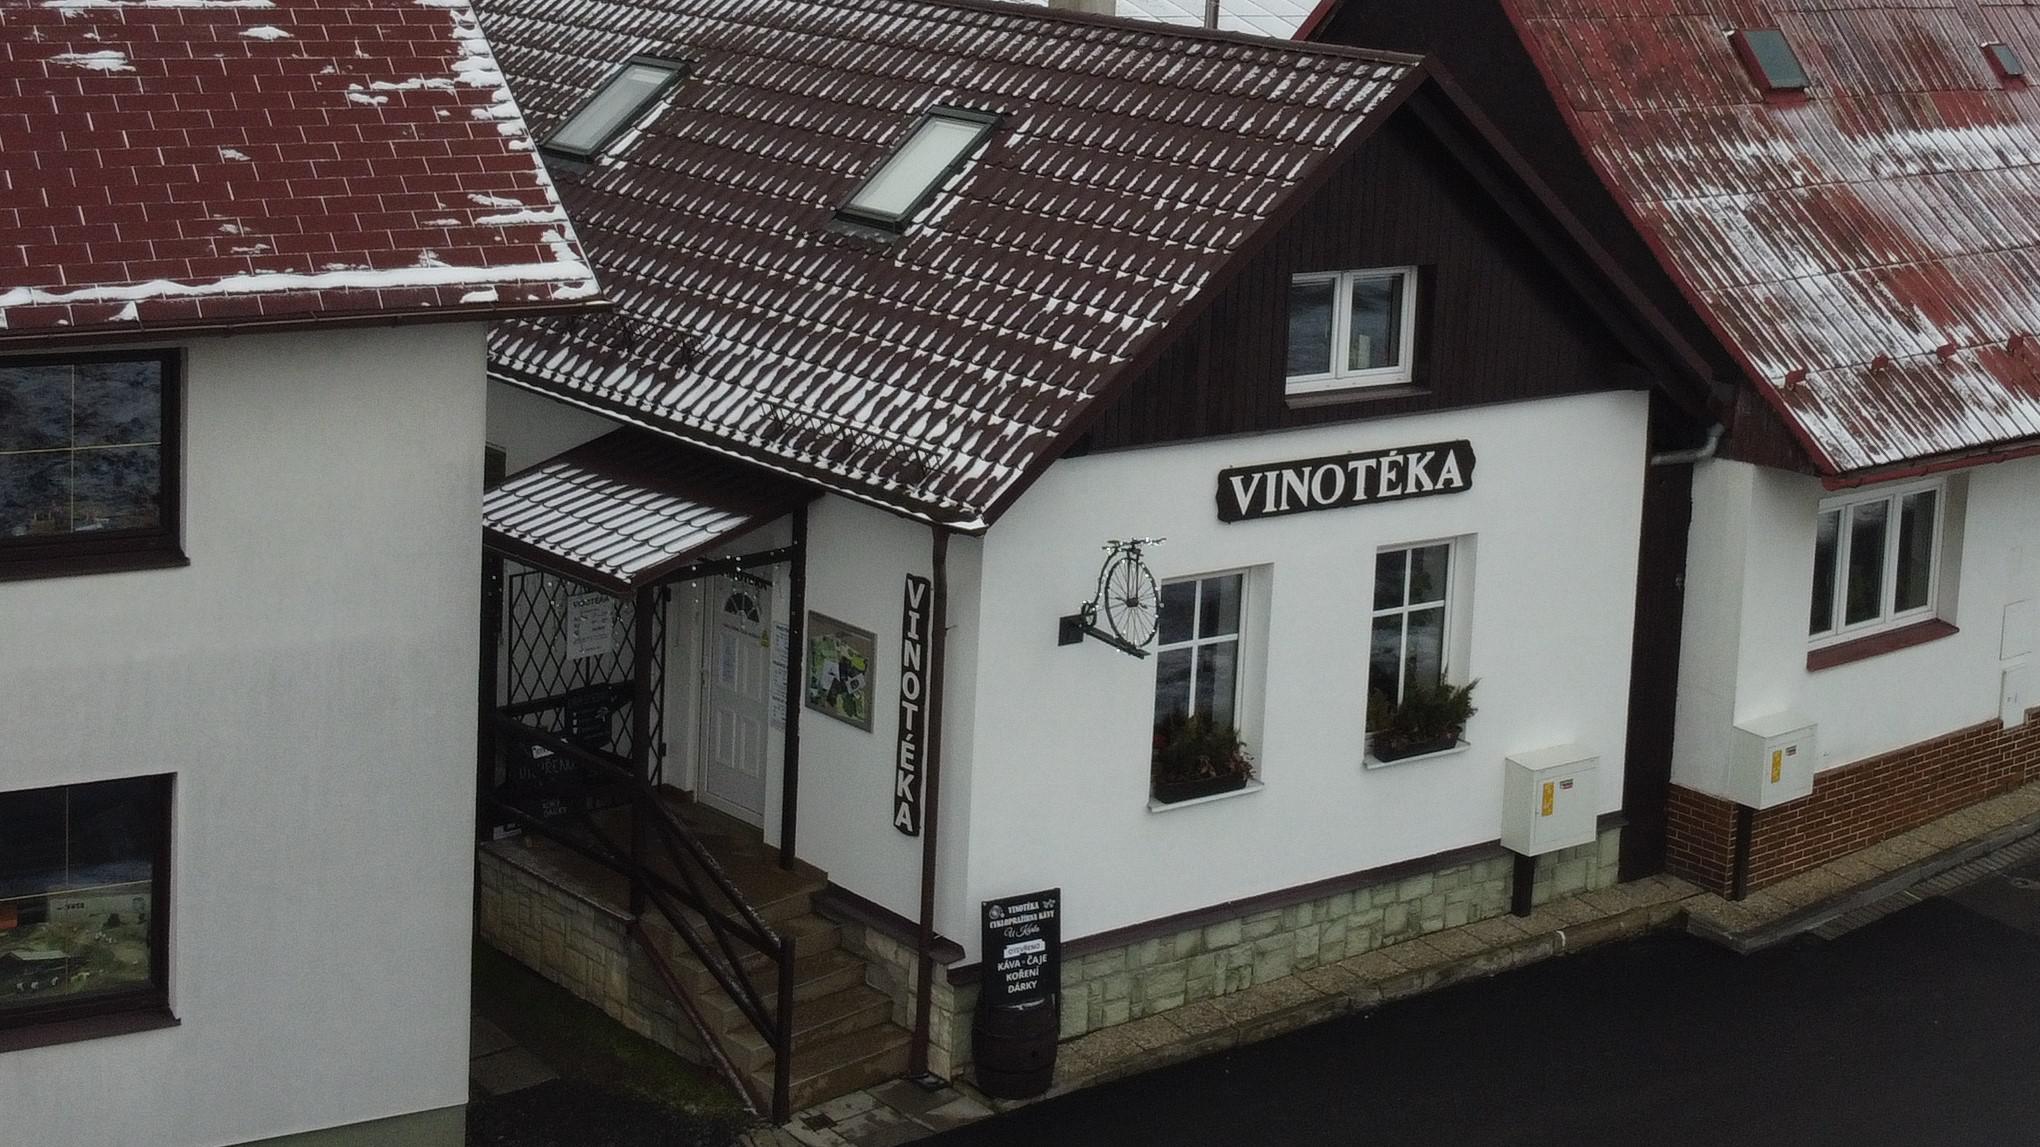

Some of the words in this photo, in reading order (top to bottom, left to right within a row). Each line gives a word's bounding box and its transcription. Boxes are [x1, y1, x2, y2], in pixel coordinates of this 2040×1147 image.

[1229, 448, 1464, 515] VINOTÉKA
[895, 579, 925, 832] VINOTÉKA
[998, 959, 1021, 971] KÁVA
[1026, 954, 1047, 966] ČAJE
[1006, 966, 1039, 982] KOŘENÍ
[1008, 980, 1037, 993] DÁRKY
